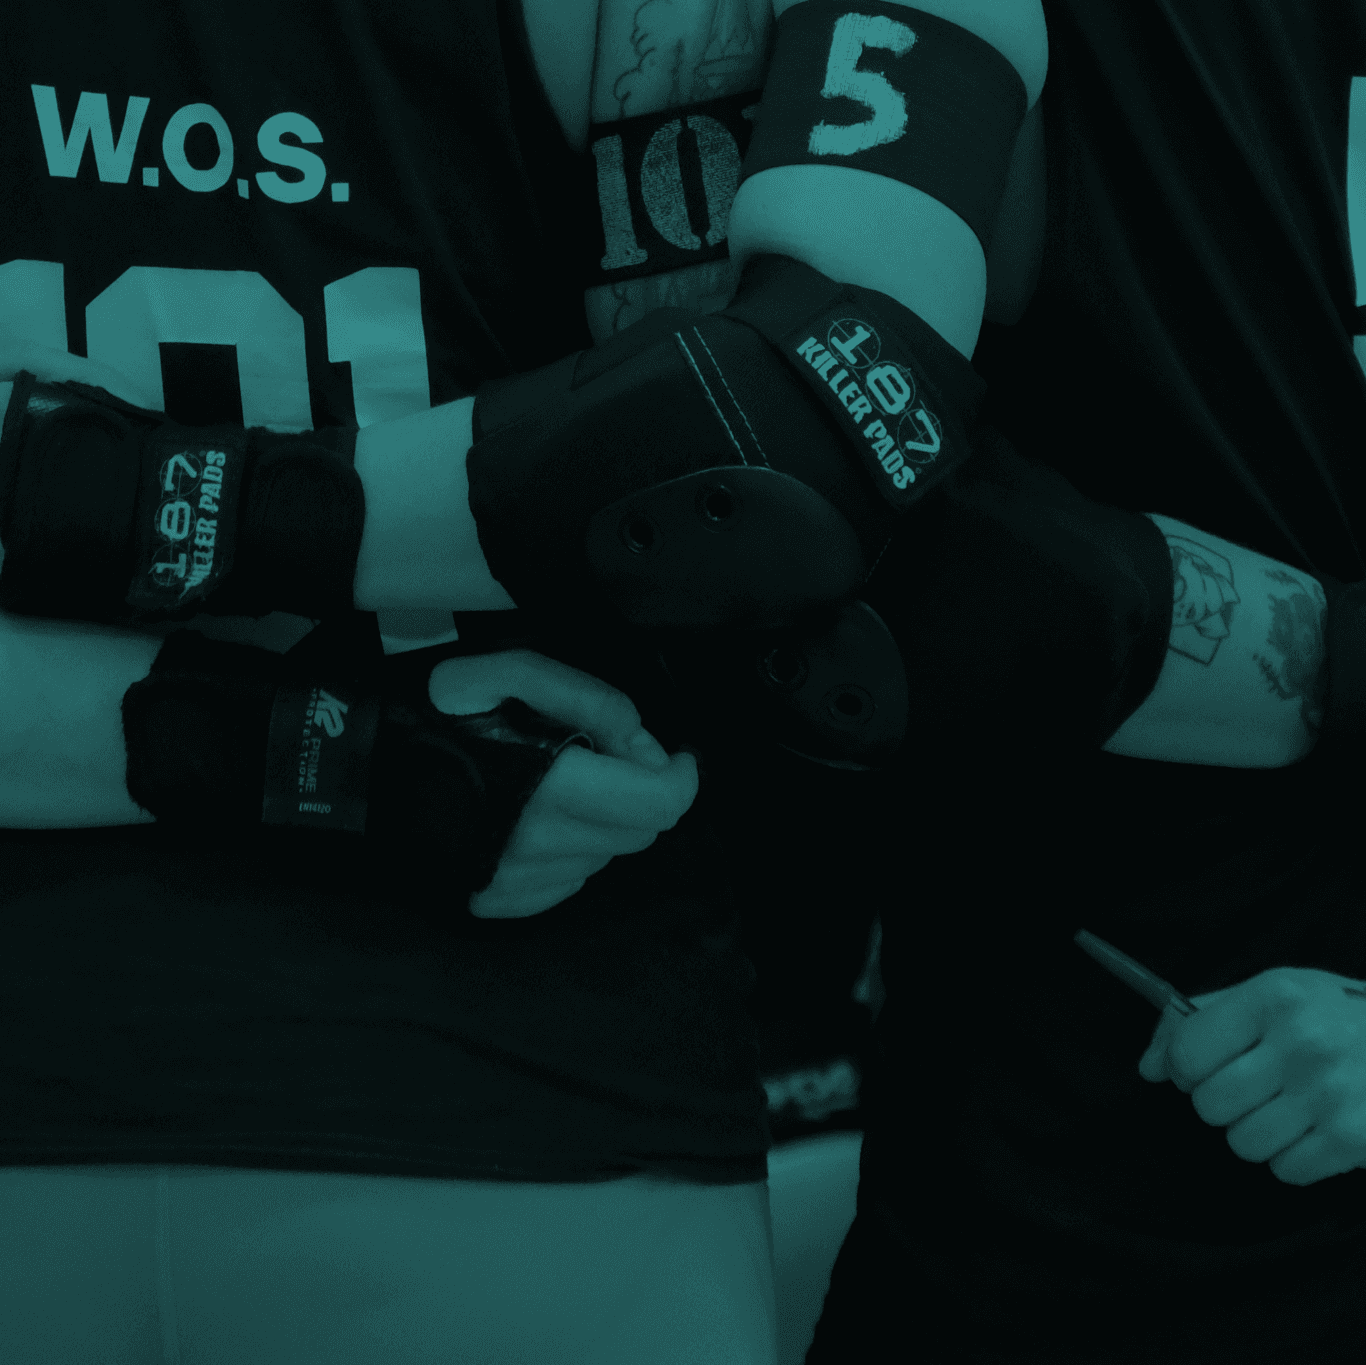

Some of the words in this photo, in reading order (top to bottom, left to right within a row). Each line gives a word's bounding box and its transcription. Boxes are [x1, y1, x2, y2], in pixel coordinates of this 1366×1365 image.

[31, 83, 351, 203] W.O.S.
[808, 13, 918, 157] 5
[591, 104, 759, 271] 10
[796, 336, 873, 424] KILLER
[863, 419, 917, 490] PADS
[831, 325, 941, 454] 187
[149, 454, 198, 578] 187
[198, 450, 227, 515] PADS
[305, 738, 322, 793] PRIME
[313, 688, 349, 738] K2
